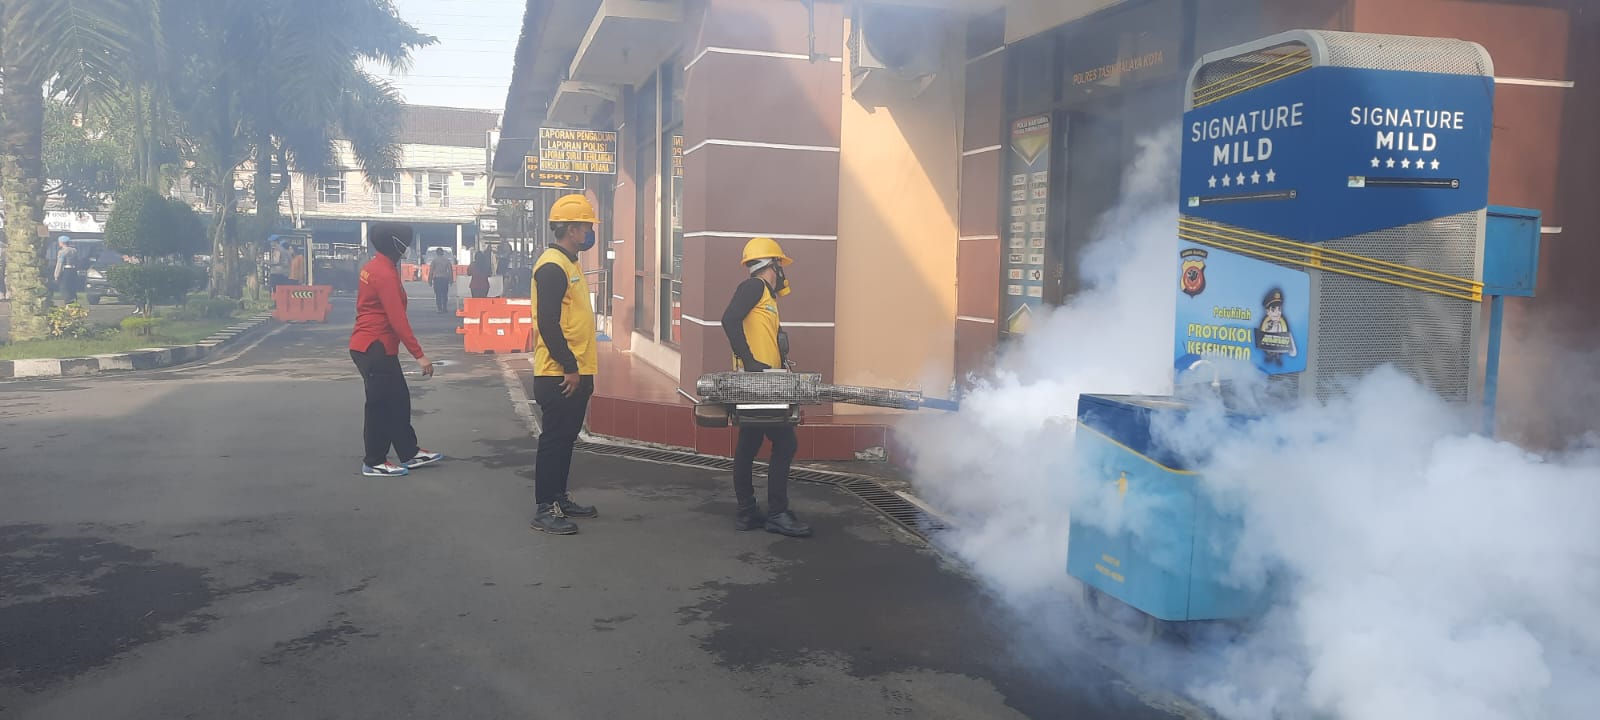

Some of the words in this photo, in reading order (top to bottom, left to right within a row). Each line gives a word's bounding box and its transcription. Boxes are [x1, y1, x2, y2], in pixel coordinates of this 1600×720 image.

[1072, 70, 1098, 84] POLRES
[1144, 51, 1163, 66] KOTA
[1191, 102, 1304, 142] SIGNATURE
[1350, 106, 1465, 129] SIGNATURE
[541, 130, 575, 140] LAPORAN
[576, 132, 616, 142] PENGADUAN
[1376, 131, 1437, 151] MILD
[547, 141, 582, 150] LAPORAN
[583, 142, 608, 152] POLISI
[1213, 137, 1273, 167] MILD
[1213, 306, 1252, 320] Patuhilah
[1188, 323, 1252, 343] PROTOKOL
[1187, 340, 1251, 360] KESEHATAN
